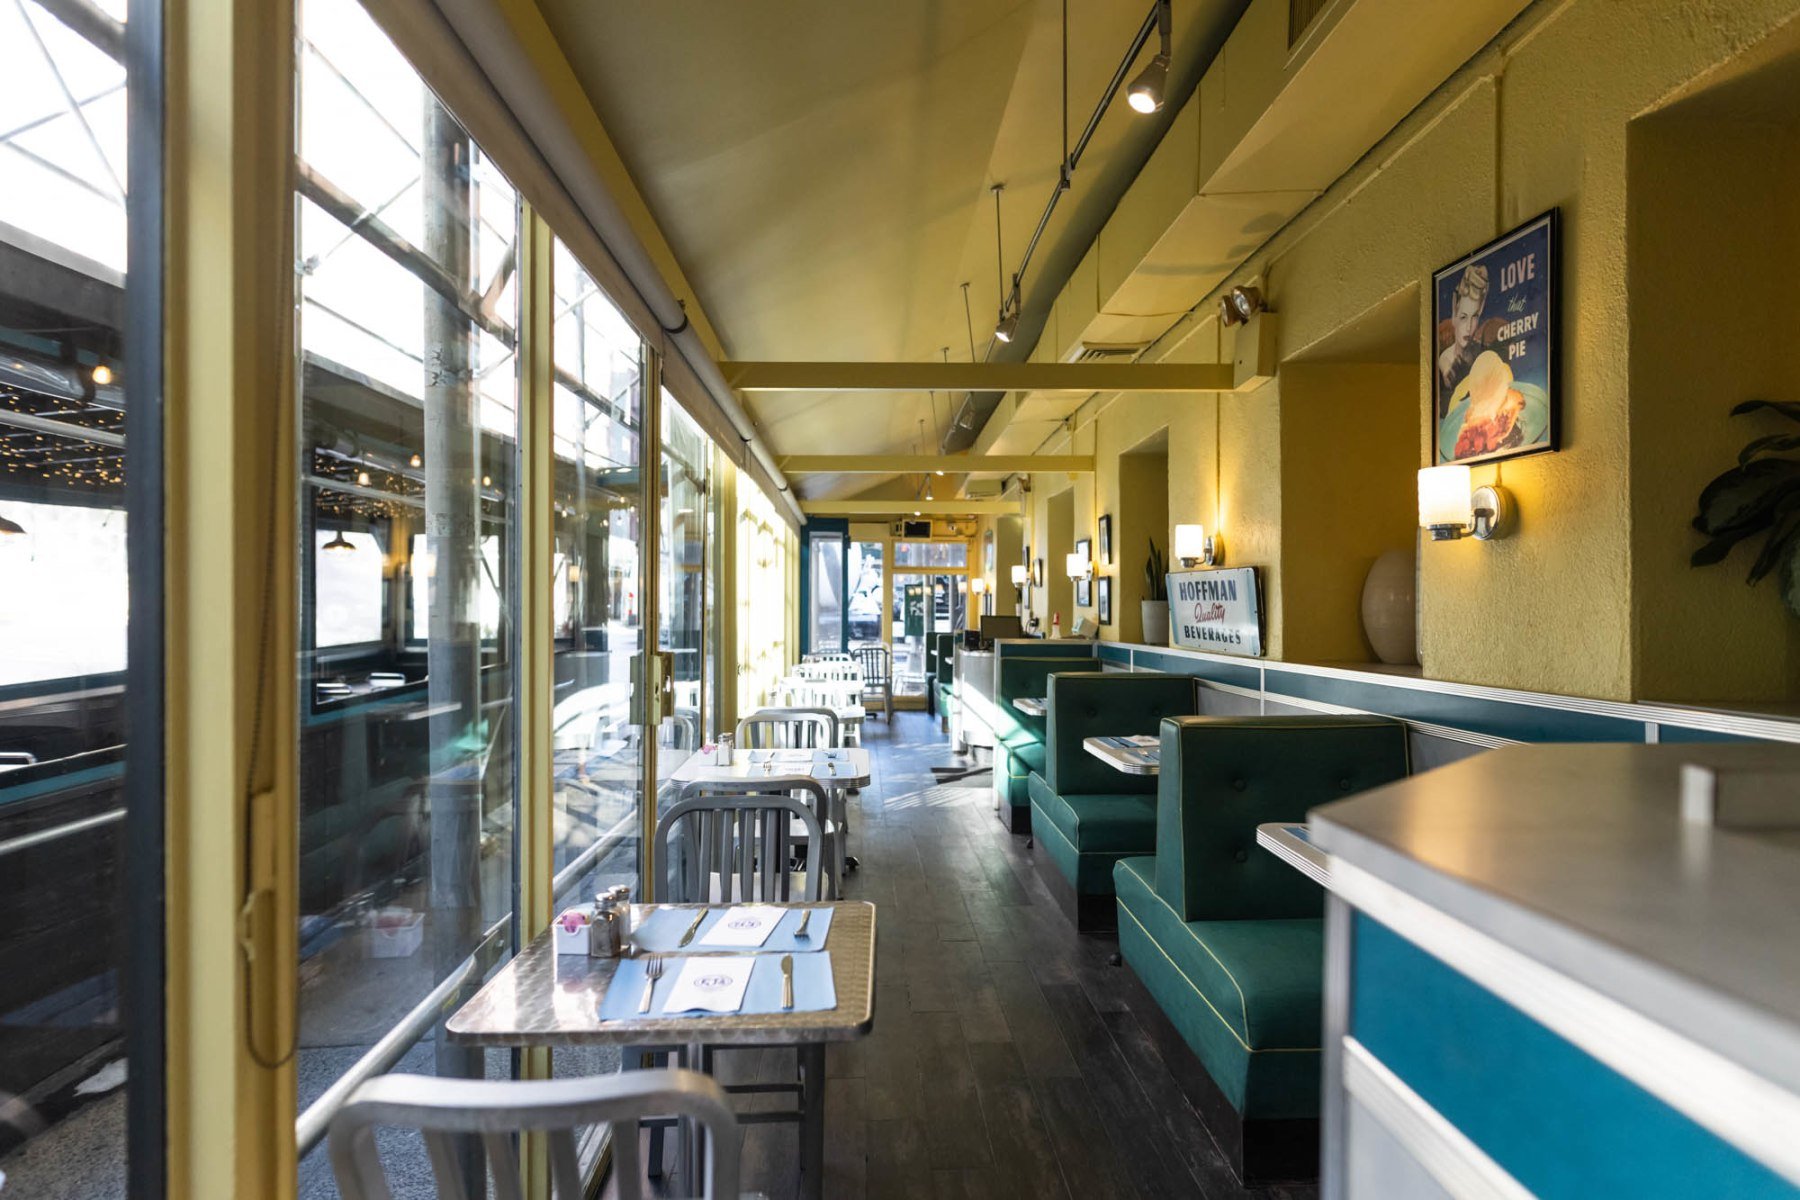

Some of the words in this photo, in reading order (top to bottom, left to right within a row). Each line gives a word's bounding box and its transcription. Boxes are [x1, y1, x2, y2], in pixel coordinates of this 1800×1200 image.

[1501, 253, 1535, 292] LOVE
[1507, 292, 1527, 312] that
[1497, 312, 1539, 342] CHERRY
[1509, 340, 1526, 361] PIE
[1179, 580, 1237, 601] HOFFMAN
[1194, 603, 1226, 624] Quality
[1184, 625, 1242, 645] BEVERAGES
